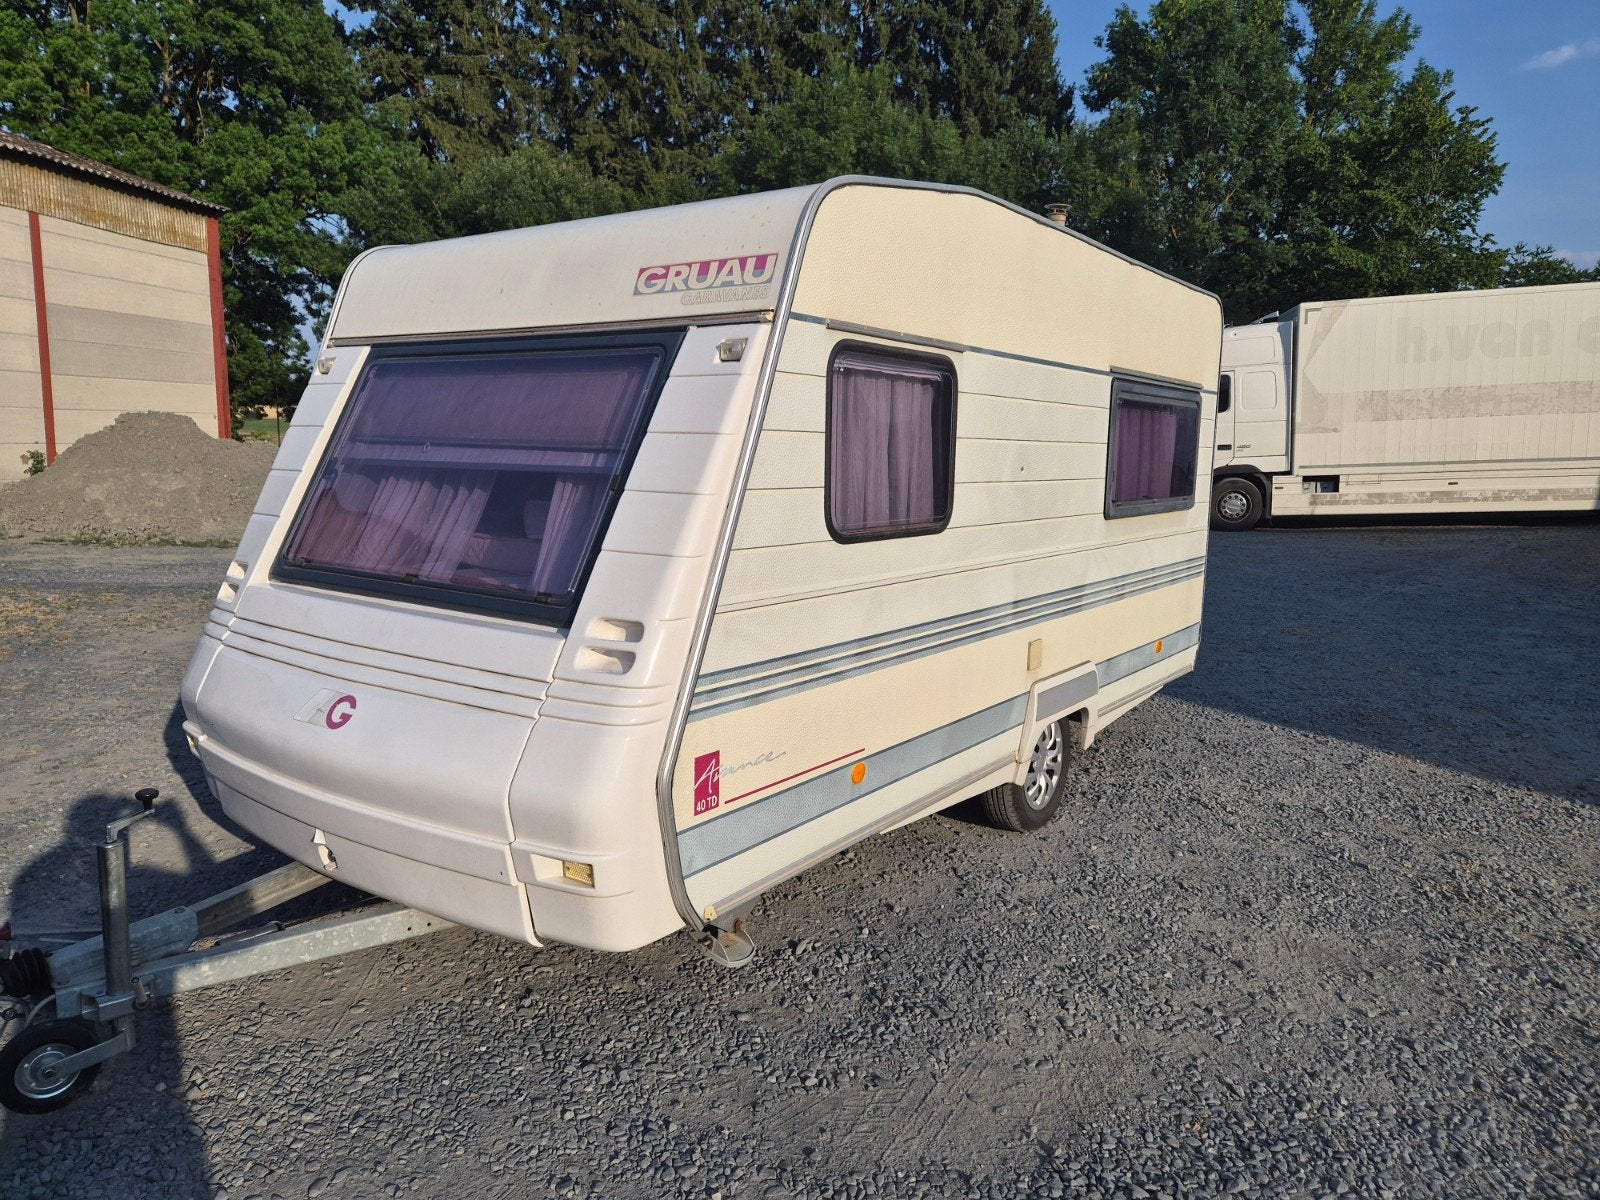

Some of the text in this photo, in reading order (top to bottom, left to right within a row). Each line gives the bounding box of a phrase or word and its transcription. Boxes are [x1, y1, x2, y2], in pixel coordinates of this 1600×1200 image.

[636, 254, 777, 294] GRUAU
[681, 285, 769, 305] CARAVANES
[326, 694, 357, 730] G
[693, 750, 787, 793] Avance
[696, 795, 718, 812] 40 TD
